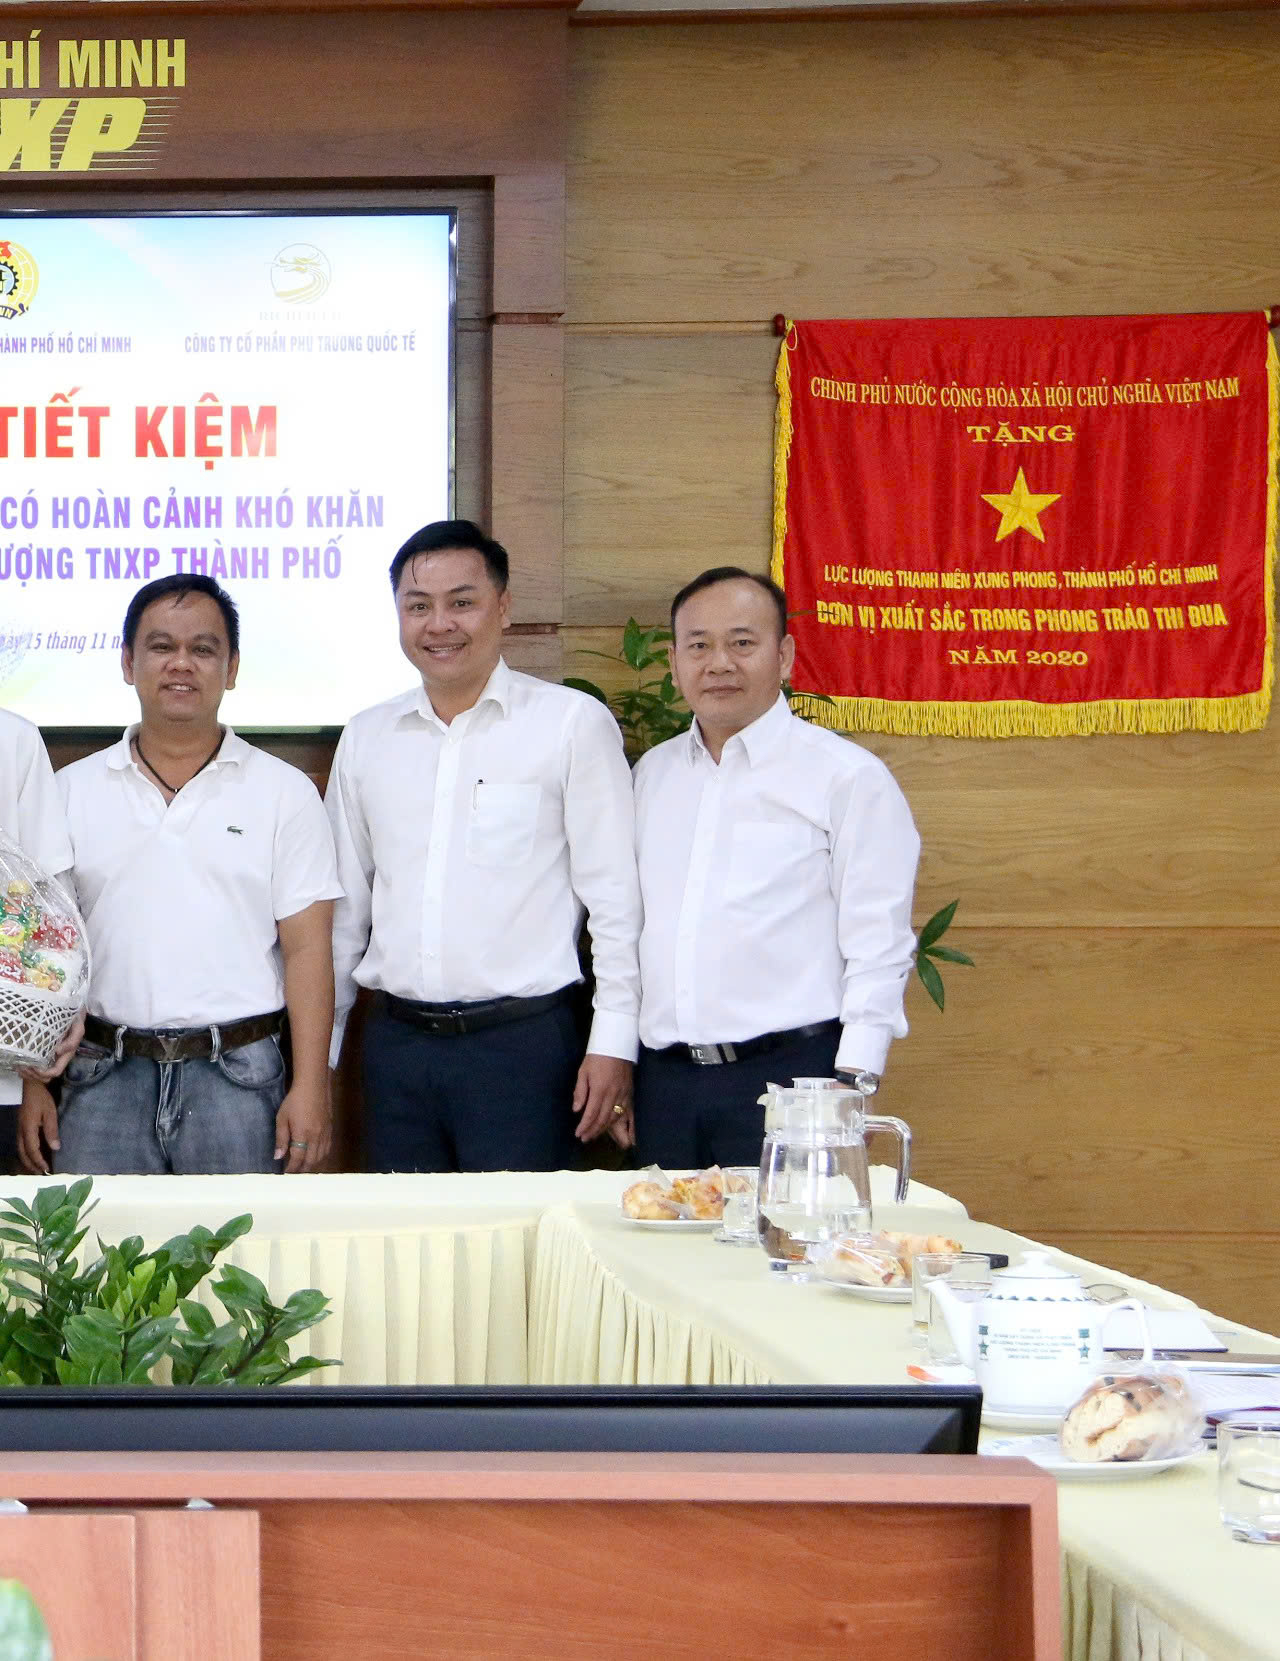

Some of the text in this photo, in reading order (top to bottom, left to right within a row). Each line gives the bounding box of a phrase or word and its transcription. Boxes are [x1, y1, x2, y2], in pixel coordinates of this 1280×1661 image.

[58, 38, 186, 88] MINH
[31, 331, 54, 354] PHỐ
[58, 331, 74, 354] HỒ
[78, 332, 98, 354] CHÍ
[101, 336, 132, 354] MINH
[184, 332, 216, 353] CÔNG
[219, 335, 233, 353] TY
[810, 375, 858, 403] CHÍNH
[860, 375, 891, 404] PHỦ
[894, 379, 937, 406] NƯỚC
[940, 380, 982, 413] CỘNG
[1020, 381, 1042, 407] XÃ
[1044, 379, 1073, 413] HỘI
[1076, 376, 1109, 407] CHỦ
[1112, 377, 1163, 404] NGHĨA
[1165, 376, 1202, 408] VIỆT
[1204, 376, 1240, 400] NAM
[135, 392, 278, 470] KIỆM
[966, 420, 1076, 447] TẶNG
[0, 488, 39, 530] CÓ
[52, 488, 131, 530] HOÀN
[143, 486, 222, 530] CẢNH
[235, 487, 295, 529] KHÓ
[307, 489, 384, 529] KHĂN
[85, 546, 161, 580] TNXP
[171, 538, 269, 579] THÀNH
[282, 534, 345, 580] PHỐ
[824, 564, 849, 587] LỰC
[851, 567, 894, 591] LƯỢNG
[896, 569, 939, 588] THANH
[941, 567, 971, 589] NIÊN
[973, 571, 1010, 589] XUNG
[1062, 566, 1108, 589] THÀNH
[1108, 560, 1137, 588] PHỐ
[1137, 560, 1158, 586] HỒ
[1159, 563, 1182, 586] CHÍ
[1184, 563, 1219, 584] MINH
[816, 599, 1229, 634] ĐƠN VỊ XUẤT SẮC TRONG PHONG TRÀO THI ĐUA
[90, 631, 107, 649] 11
[948, 644, 1089, 666] NĂM 2020
